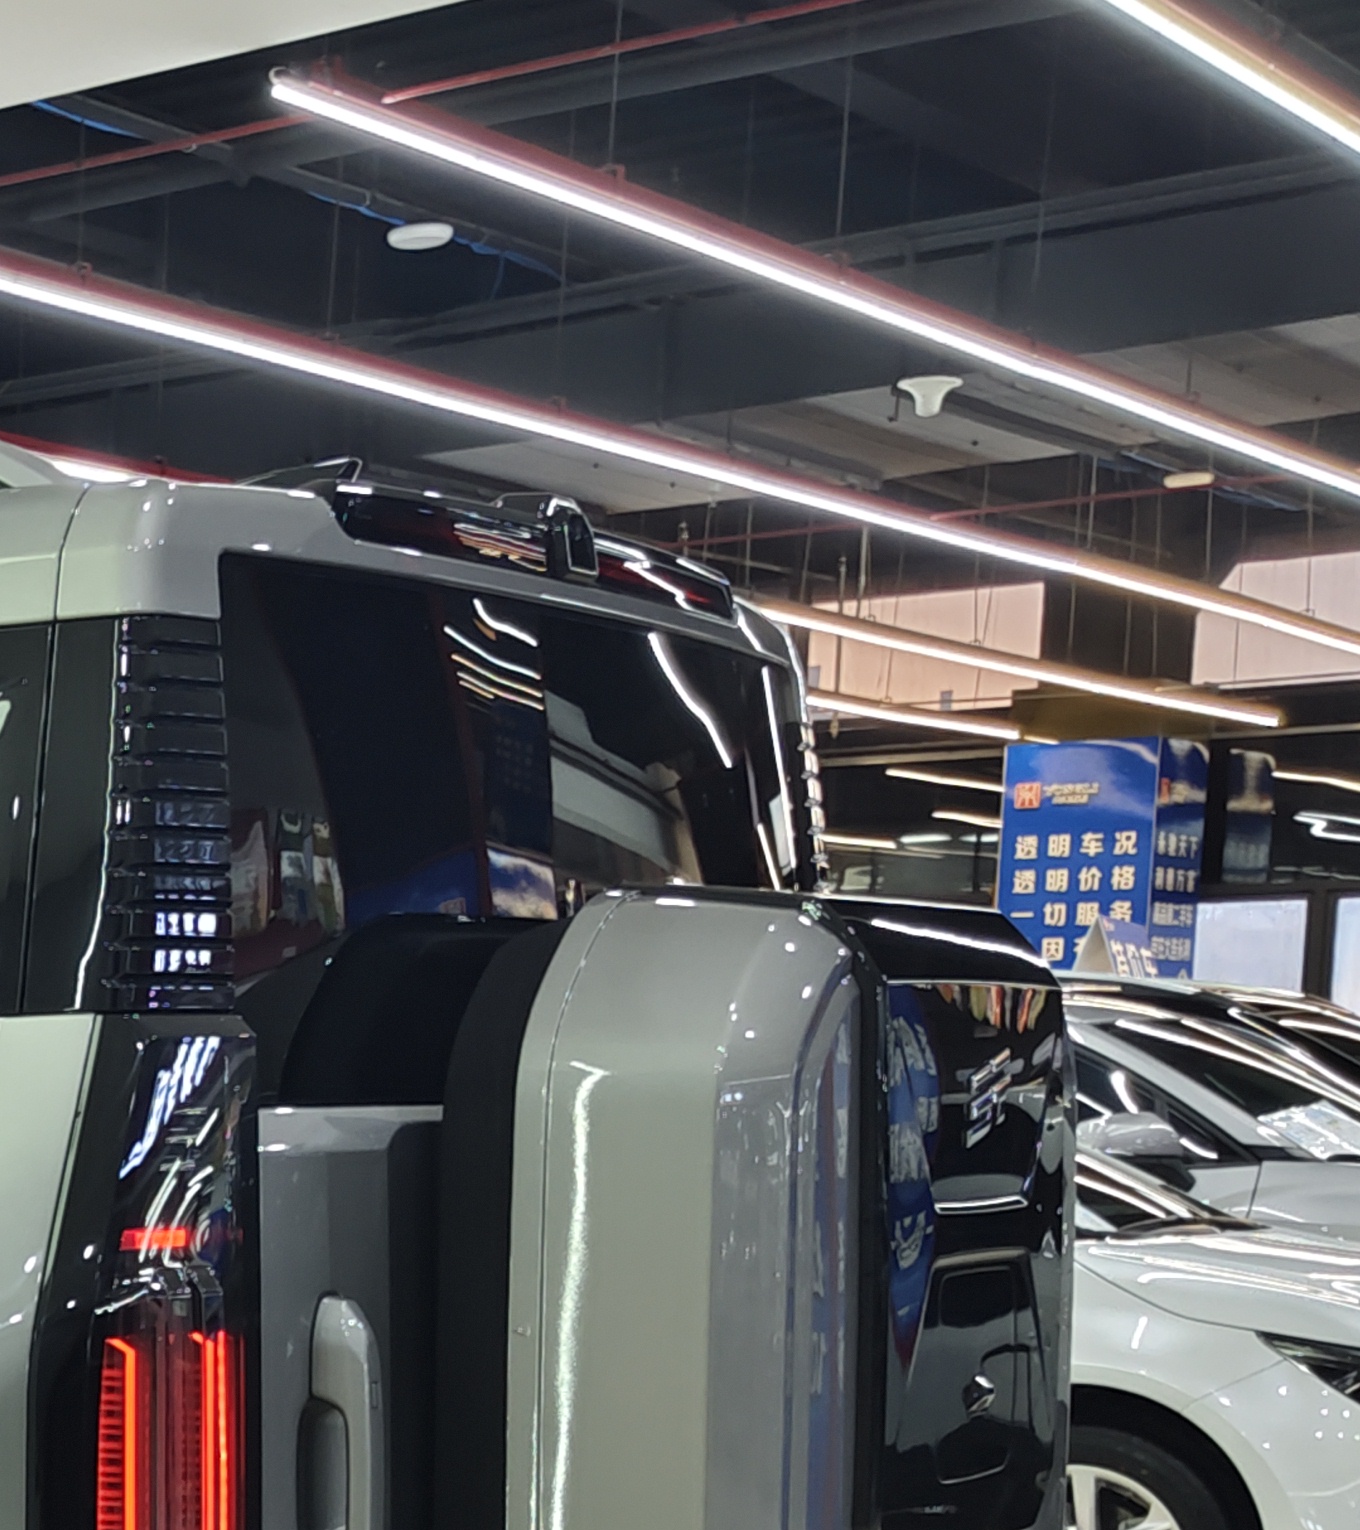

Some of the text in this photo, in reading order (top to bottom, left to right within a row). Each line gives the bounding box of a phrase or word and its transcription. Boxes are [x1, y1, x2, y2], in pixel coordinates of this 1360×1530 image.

[1014, 830, 1139, 860] 透明车况
[1012, 865, 1136, 895] 透明价格
[1010, 900, 1133, 927] 一切服务
